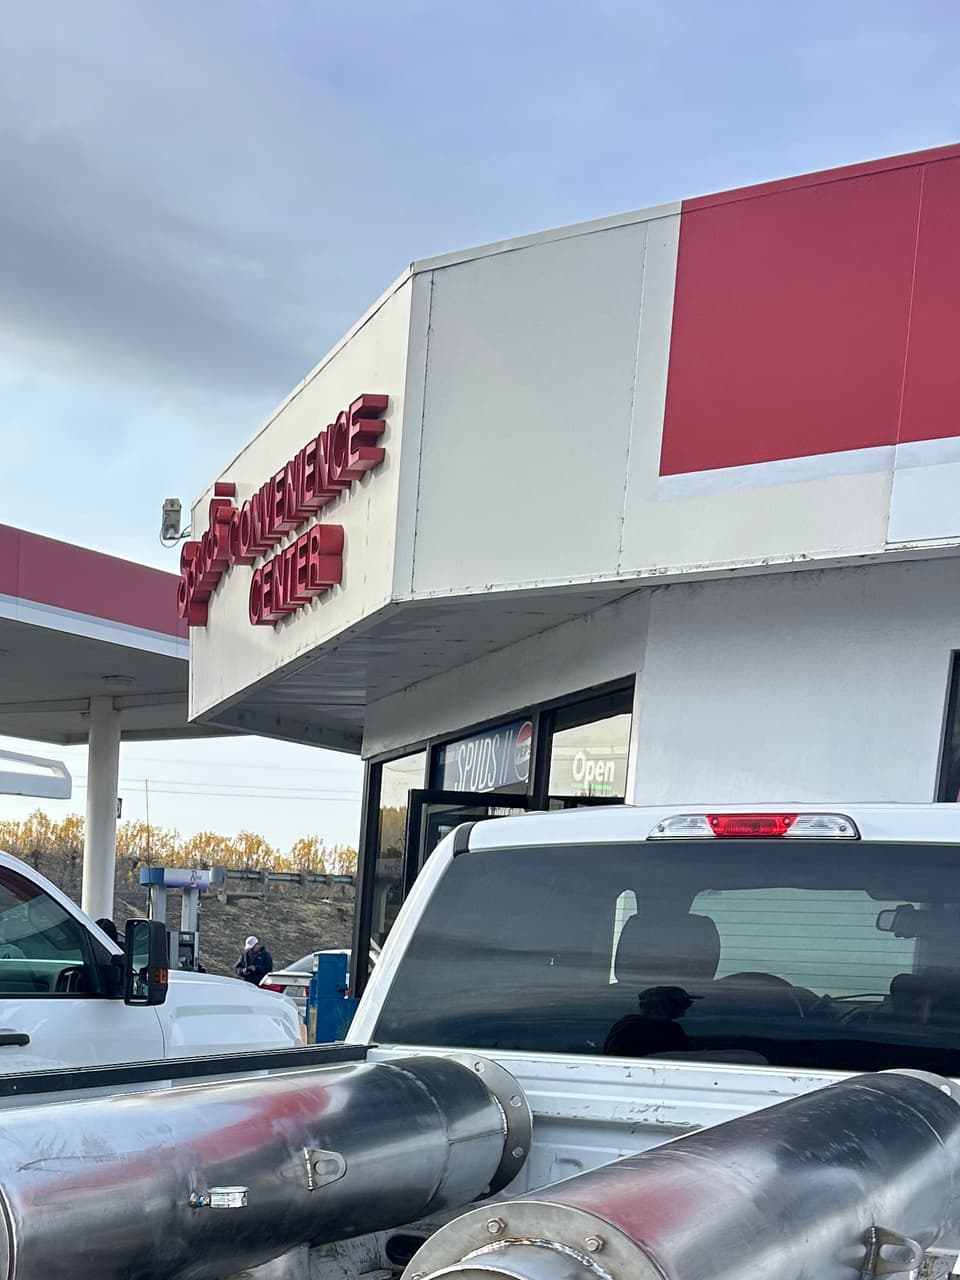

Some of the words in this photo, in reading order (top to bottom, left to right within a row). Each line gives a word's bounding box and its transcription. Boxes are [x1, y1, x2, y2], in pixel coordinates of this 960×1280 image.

[228, 393, 389, 566] CONVENIENCE
[249, 523, 344, 626] CENTER
[454, 733, 501, 792] SPUDS
[572, 750, 616, 793] Open
